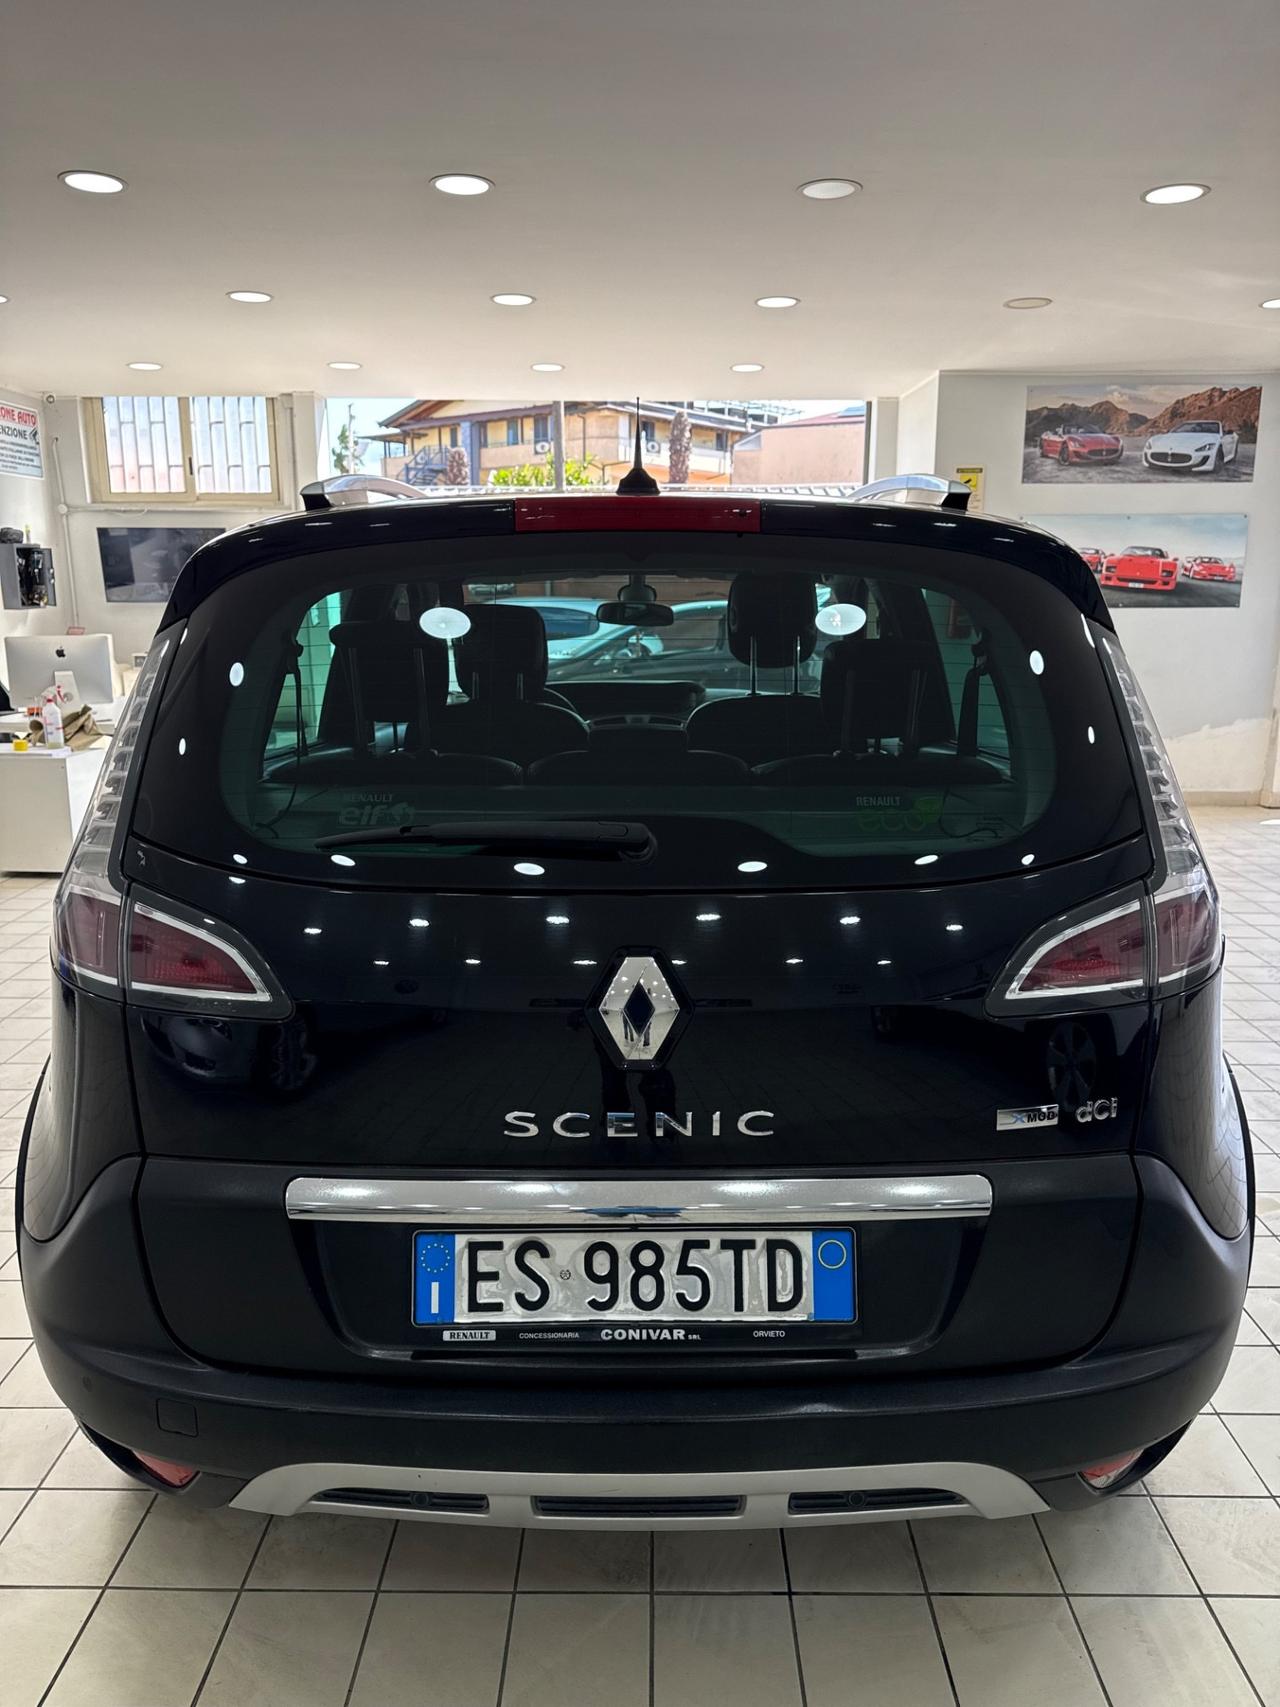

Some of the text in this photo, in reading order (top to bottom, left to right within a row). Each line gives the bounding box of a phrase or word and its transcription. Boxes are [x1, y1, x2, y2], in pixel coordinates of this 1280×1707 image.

[0, 406, 37, 427] ONE AUTO
[0, 425, 28, 440] NZIONE
[856, 795, 901, 807] RENAULT
[338, 804, 388, 825] elf
[1075, 1097, 1118, 1123] dCi
[503, 1110, 775, 1138] SCENIC
[467, 1238, 805, 1312] ES 985TD
[431, 1281, 440, 1314] I
[450, 1331, 491, 1340] RENAULT
[518, 1331, 580, 1340] CONCESSIONARIA
[600, 1328, 686, 1341] CONIVAR
[752, 1329, 786, 1338] ORVIETO
